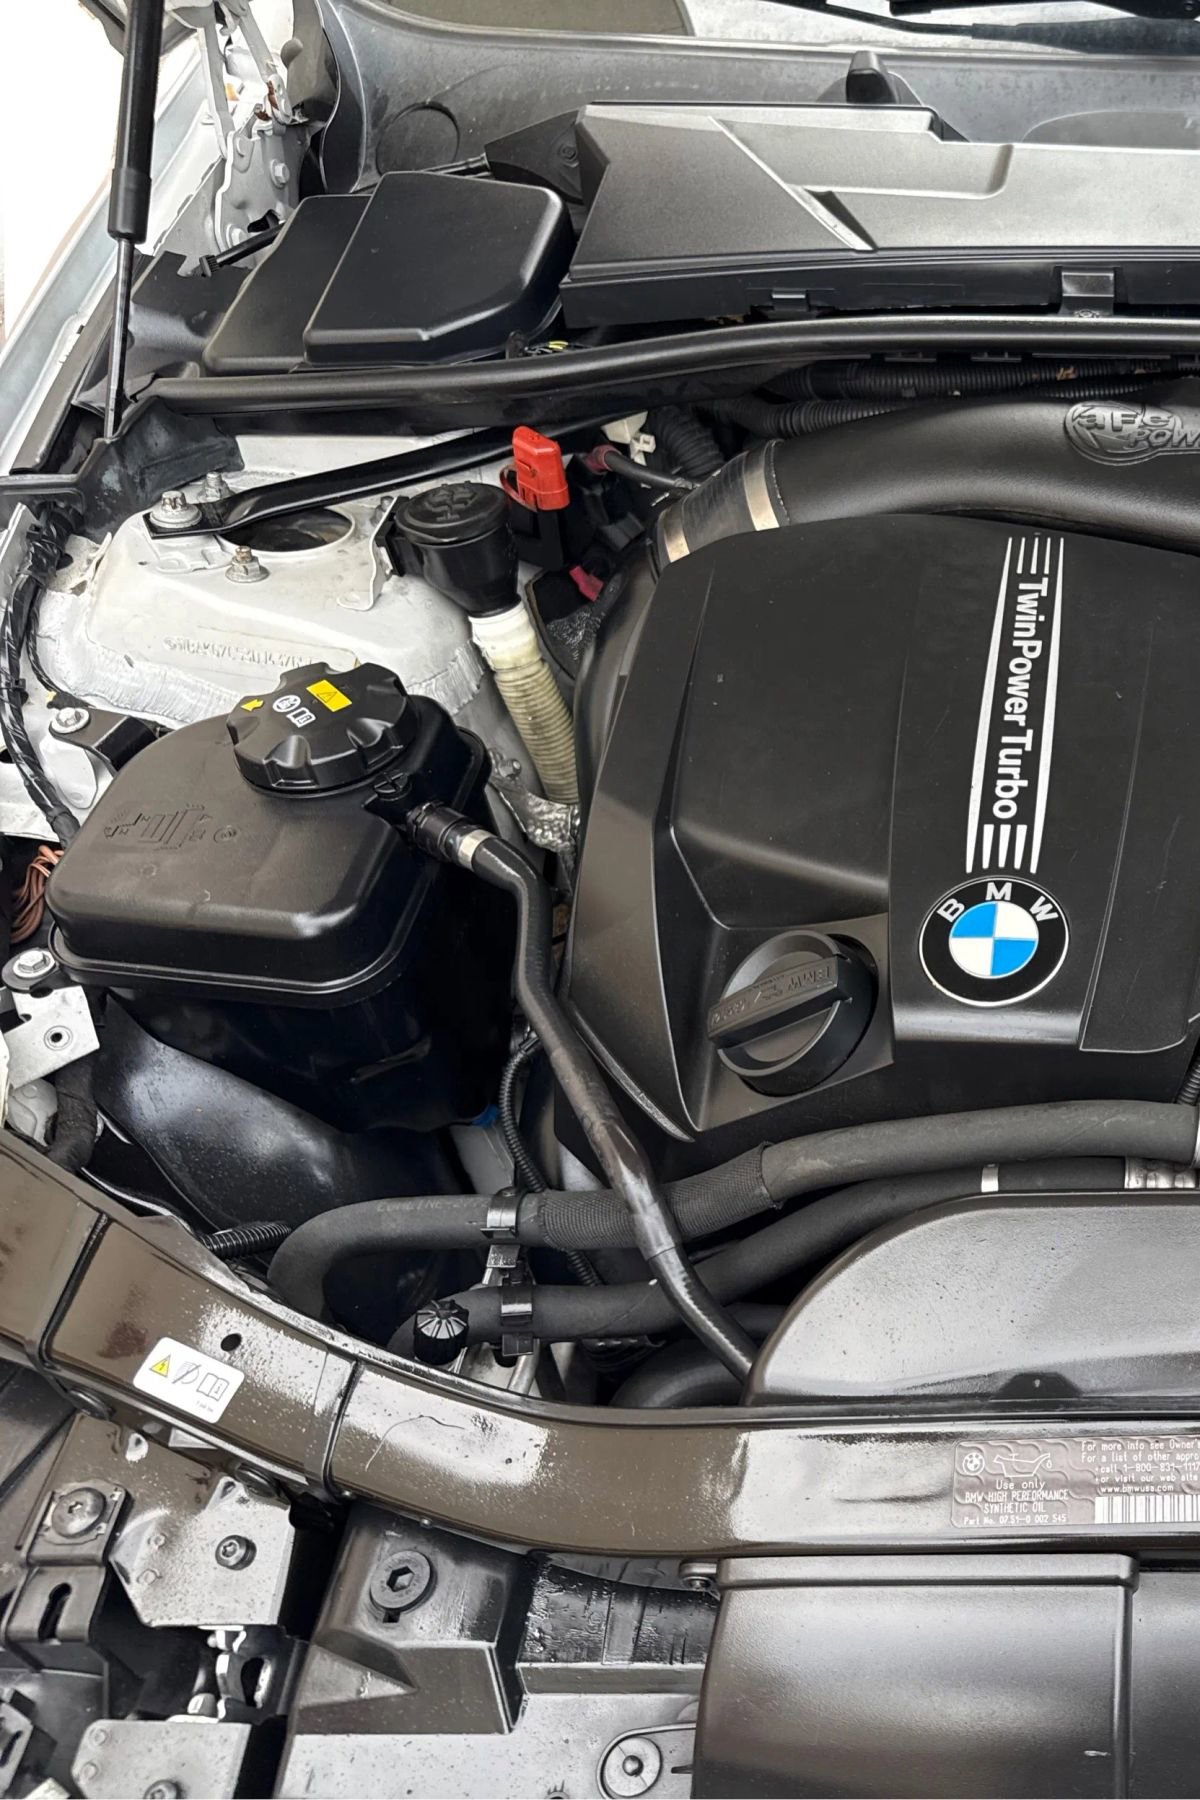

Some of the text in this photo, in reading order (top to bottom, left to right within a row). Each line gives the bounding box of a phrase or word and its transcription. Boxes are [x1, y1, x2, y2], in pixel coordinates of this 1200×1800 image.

[992, 576, 1049, 819] TwinPower Turbo
[936, 882, 1058, 923] BMW
[1081, 1440, 1097, 1451] For
[1101, 1442, 1122, 1451] more
[1127, 1440, 1145, 1450] info
[1150, 1441, 1165, 1450] see
[1081, 1452, 1097, 1463] For
[1112, 1452, 1127, 1462] list
[1133, 1451, 1143, 1461] of
[1148, 1452, 1171, 1461] other
[1100, 1464, 1118, 1474] call
[1115, 1474, 1135, 1483] visit
[1160, 1474, 1177, 1482] web
[1181, 1473, 1198, 1482] site
[996, 1480, 1046, 1492] Use only
[1100, 1484, 1174, 1493] www.bmwusa.com
[965, 1489, 1069, 1503] BMW HIGH PERFORMANCE
[983, 1502, 1046, 1514] SYNTHETIC OIL
